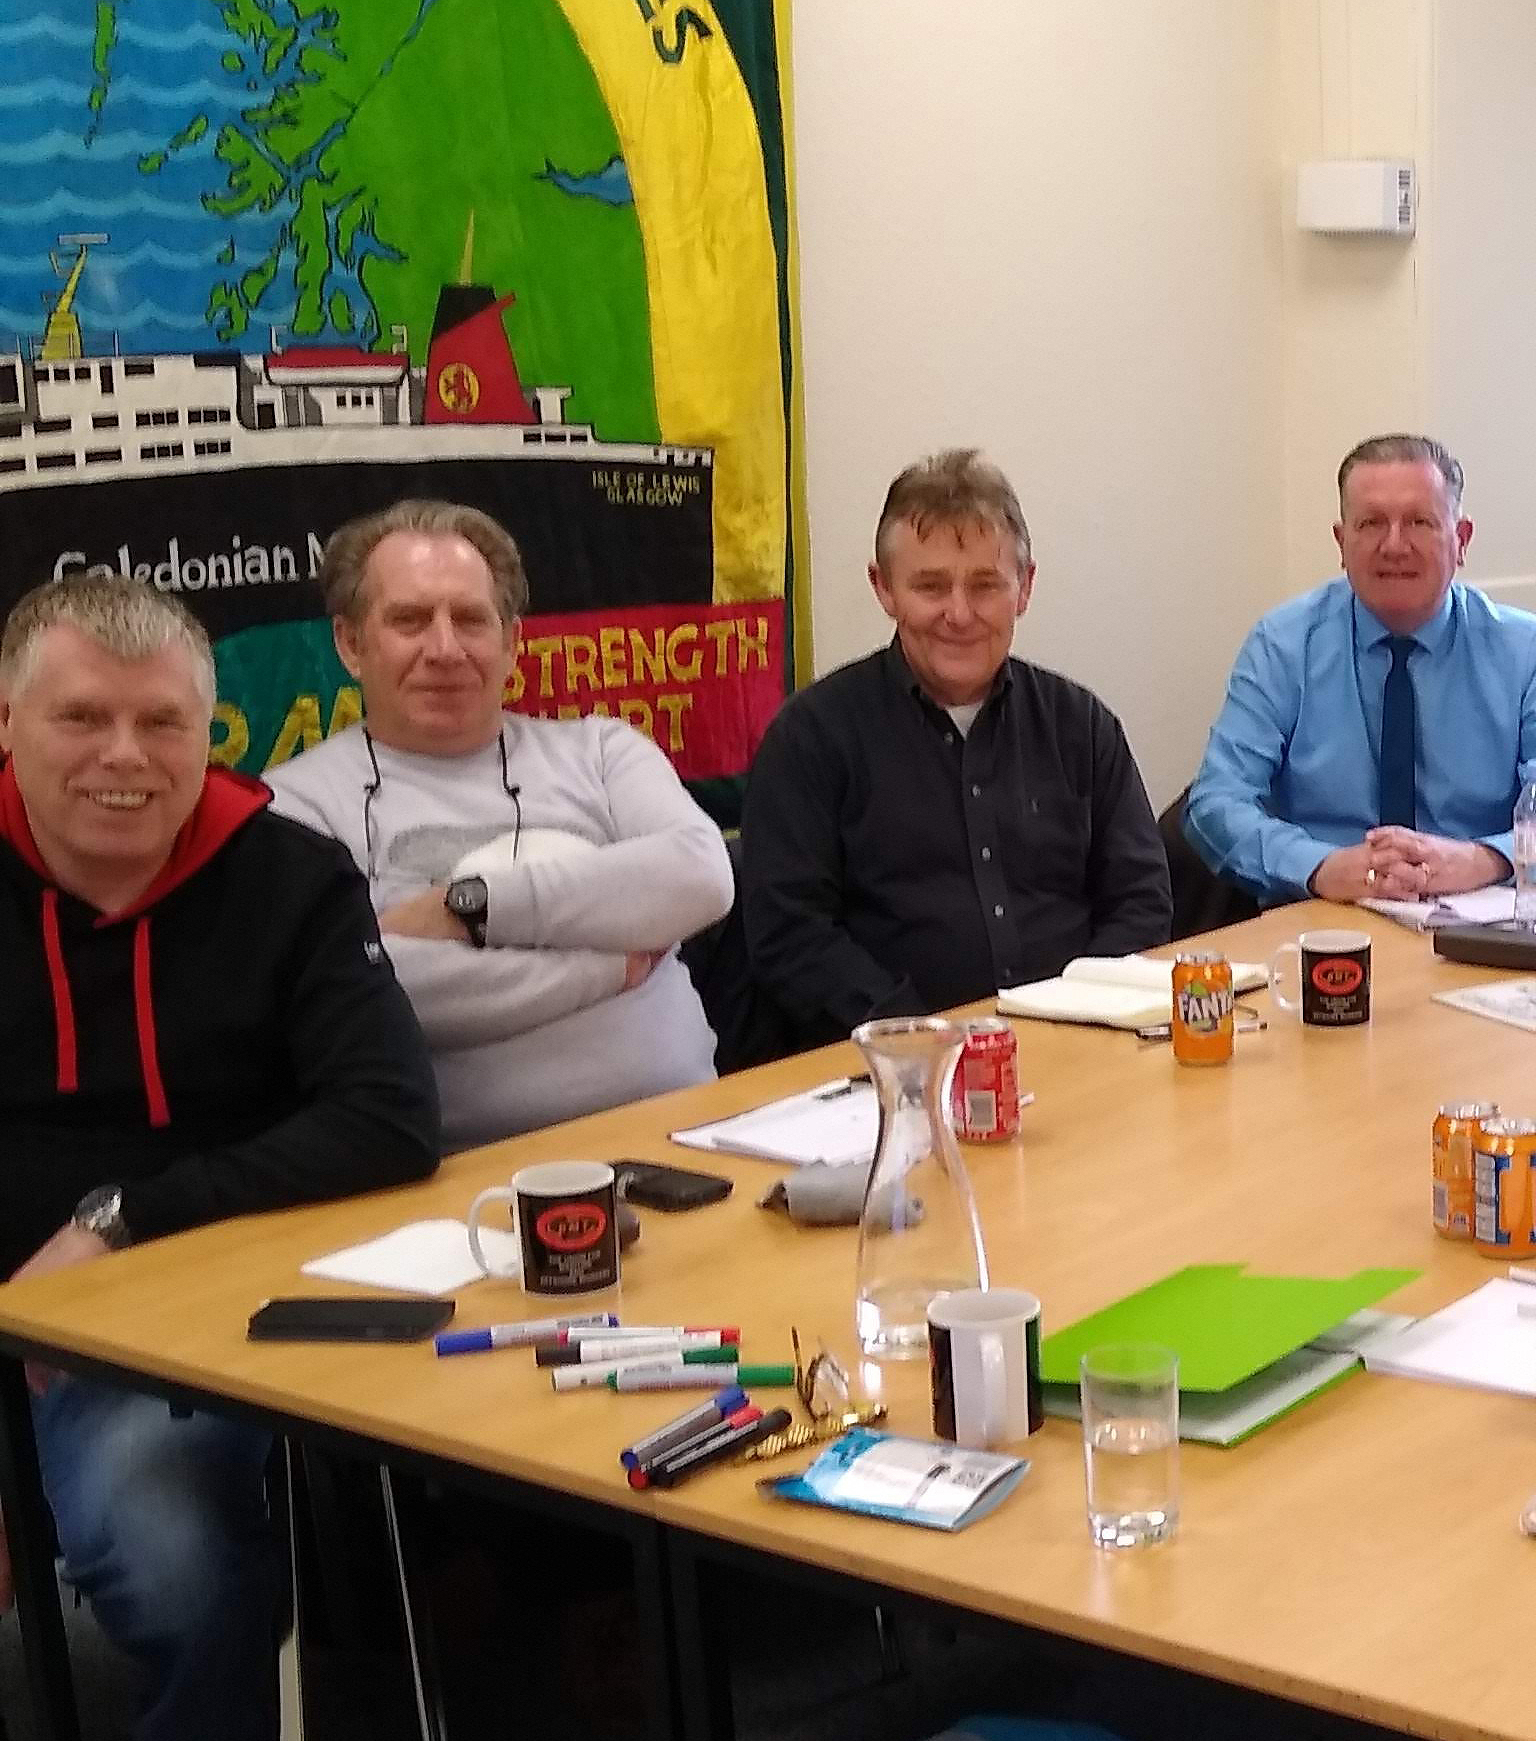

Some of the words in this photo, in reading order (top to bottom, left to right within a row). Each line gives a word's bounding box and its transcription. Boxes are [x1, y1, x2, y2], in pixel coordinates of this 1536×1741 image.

[592, 470, 622, 489] ISLE
[626, 472, 645, 488] OF
[652, 471, 700, 495] LEWIS
[607, 486, 683, 506] GLASGOW
